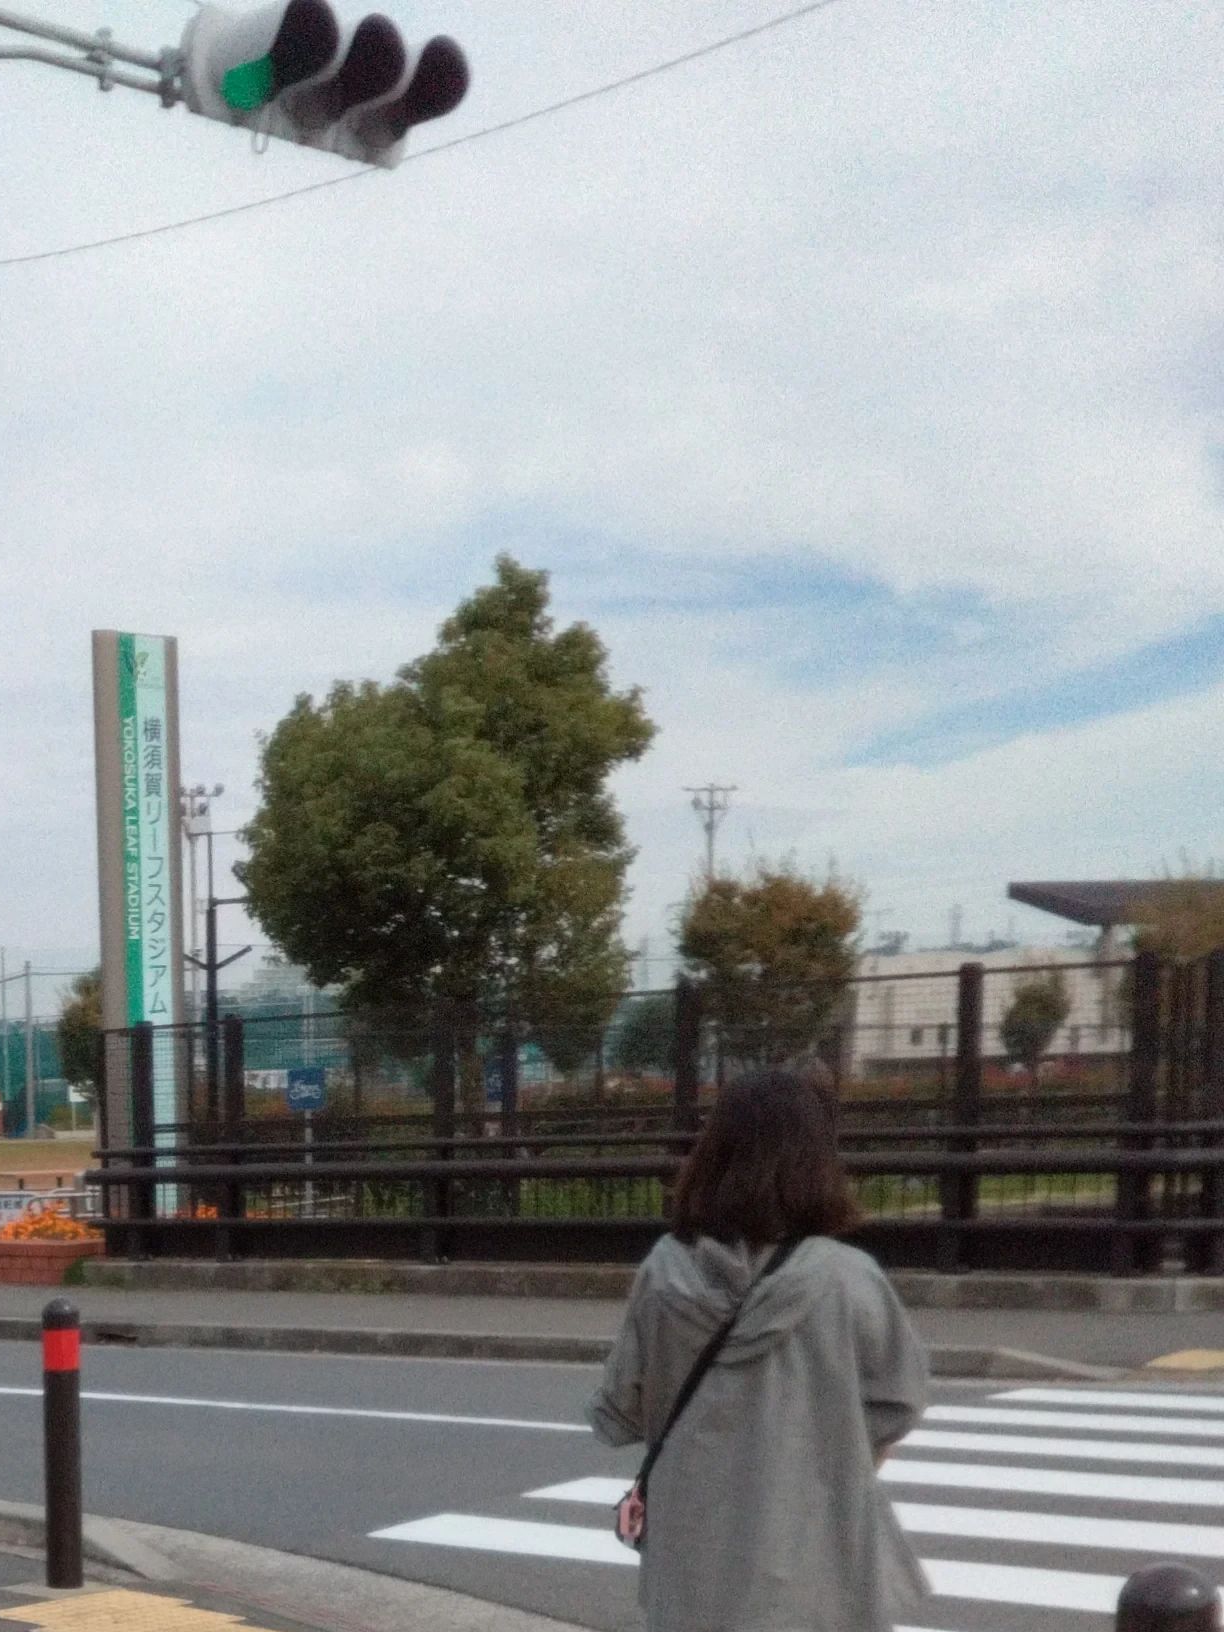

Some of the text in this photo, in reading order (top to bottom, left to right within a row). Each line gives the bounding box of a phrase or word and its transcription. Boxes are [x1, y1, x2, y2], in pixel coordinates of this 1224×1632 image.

[122, 715, 141, 939] YOKOSUKA LEAF STADIUM
[143, 716, 168, 1014] 横須賀リーフスタジアム
